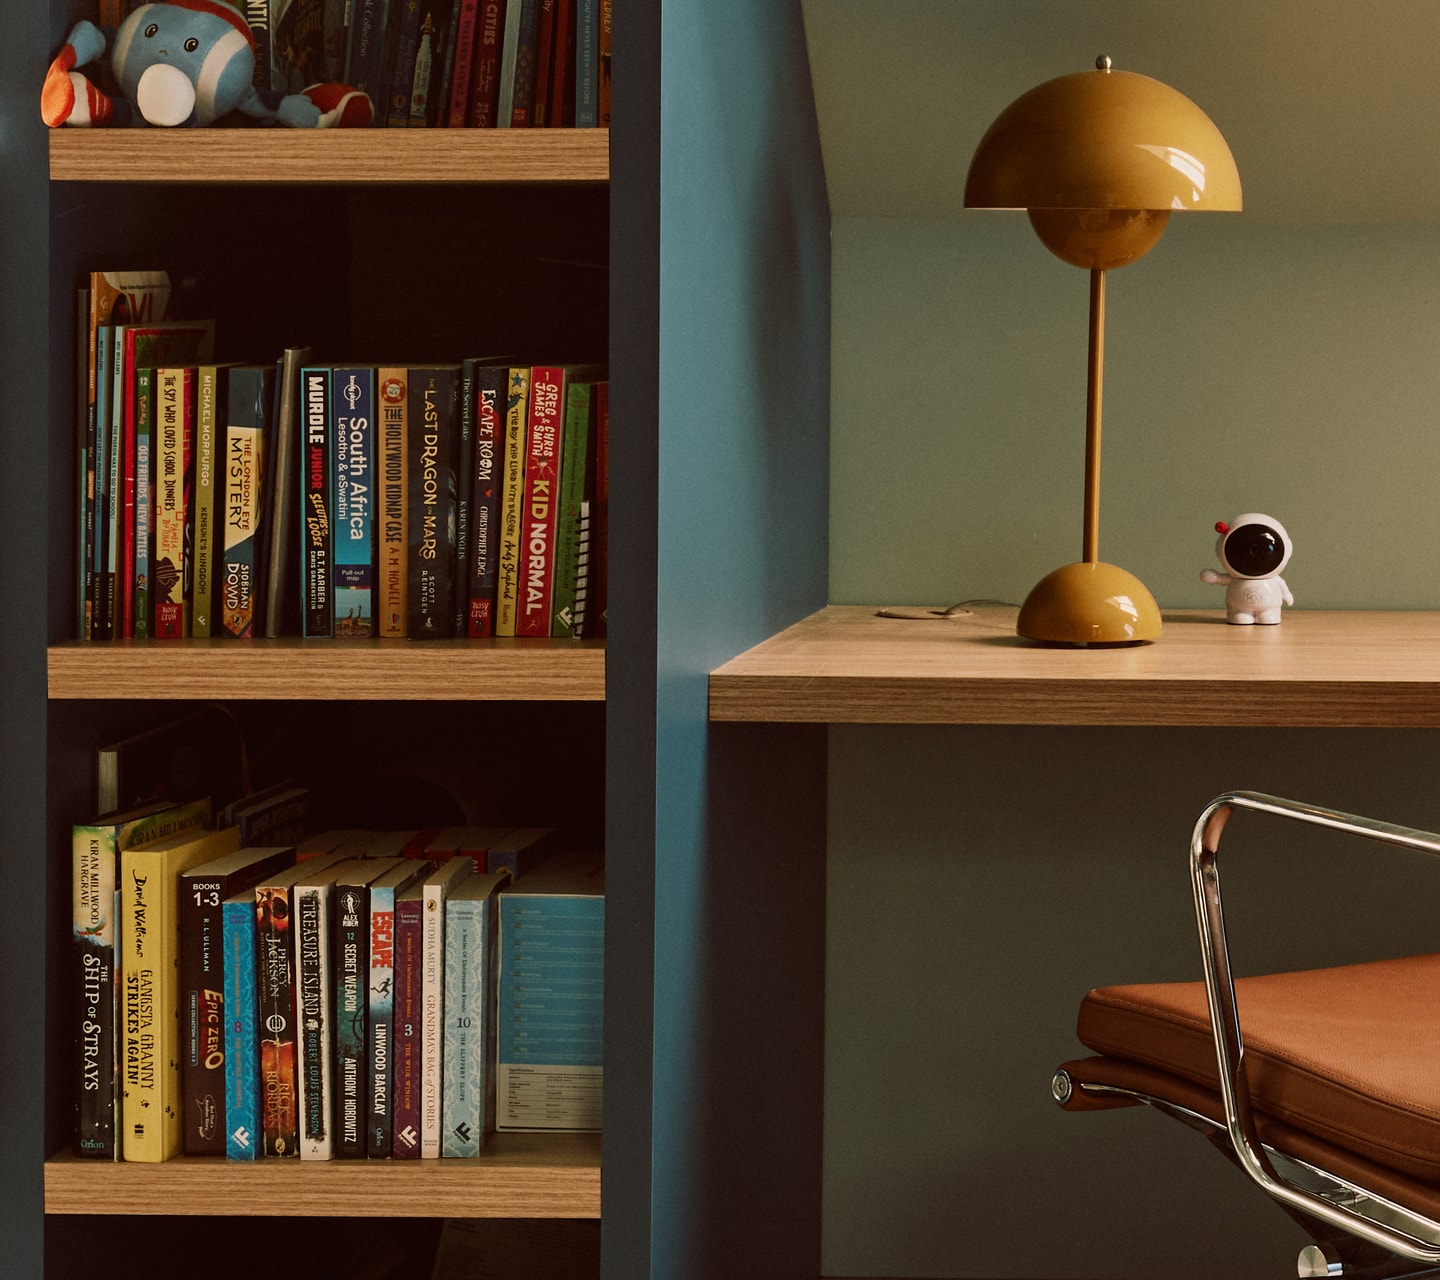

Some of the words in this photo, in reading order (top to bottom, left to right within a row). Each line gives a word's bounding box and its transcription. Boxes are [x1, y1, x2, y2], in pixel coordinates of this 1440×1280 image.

[484, 4, 498, 45] CITIES
[164, 376, 176, 387] THE
[164, 388, 177, 402] SPY
[203, 376, 212, 423] MICHAEL
[534, 382, 546, 417] JAMES
[545, 384, 558, 416] GREG
[164, 405, 177, 423] WHO
[384, 408, 403, 420] THE
[164, 426, 176, 449] LOVED
[201, 425, 211, 487] MORPURGO
[244, 437, 252, 457] THE
[338, 417, 348, 461] Lesotho
[349, 417, 368, 476] South
[385, 423, 402, 482] HOLLYWOOD
[531, 424, 544, 456] SMITH
[543, 425, 556, 457] CHRIS
[164, 451, 177, 476] SCHOOL
[229, 437, 243, 530] MYSTERY
[243, 460, 251, 507] LONDON
[338, 463, 348, 472] &
[164, 480, 177, 511] DINNERS
[338, 474, 348, 520] eSwatini
[349, 481, 368, 540] Africa
[385, 484, 402, 519] KIDNAP
[459, 501, 467, 529] KAREN
[531, 480, 550, 520] KID
[200, 507, 208, 550] KENSUKE'S
[242, 511, 250, 530] EYE
[385, 521, 402, 543] CASE
[458, 531, 466, 560] INGLIS
[198, 552, 207, 595] KINGDOM
[226, 562, 239, 609] DOWD
[240, 564, 249, 609] SIOBHAN
[526, 523, 548, 616] NORMAL
[90, 839, 99, 870] KIRAN
[81, 855, 89, 908] HARGRAVE
[90, 873, 100, 924] MILLWOOD
[133, 869, 147, 907] David
[192, 883, 221, 891] BOOKS
[193, 891, 220, 907] 1-3
[134, 909, 147, 958] Walliams
[302, 900, 318, 966] TREASURE
[371, 911, 394, 969] ESCAPE
[100, 965, 108, 983] THE
[265, 933, 281, 998] JACKSON
[278, 948, 287, 988] PERCY
[344, 943, 357, 973] SECRET
[82, 953, 101, 1004] SHIP
[303, 972, 319, 1015] ISLAND
[344, 975, 357, 1012] WEAPON
[87, 1006, 96, 1019] OF
[127, 976, 139, 1034] STRIKES
[140, 969, 153, 1029] GANGSTA
[203, 989, 224, 1023] EPIC
[404, 1024, 414, 1037] 3
[456, 1016, 471, 1028] 10
[82, 1020, 102, 1091] STRAYS
[127, 1038, 139, 1085] AGAIN!
[140, 1034, 154, 1090] GRANNY
[204, 1027, 224, 1070] ZERO
[308, 1032, 318, 1062] ROBERT
[374, 1023, 387, 1071] LINWOOD
[309, 1065, 319, 1089] LOUIS
[344, 1057, 357, 1097] ANTHONY
[374, 1073, 386, 1116] BARCLAY
[266, 1071, 278, 1128] RIORDAN
[278, 1083, 291, 1114] RICK
[309, 1092, 319, 1134] STEVENSON
[344, 1099, 357, 1143] HOROWITZ
[80, 1139, 104, 1148] Orion
